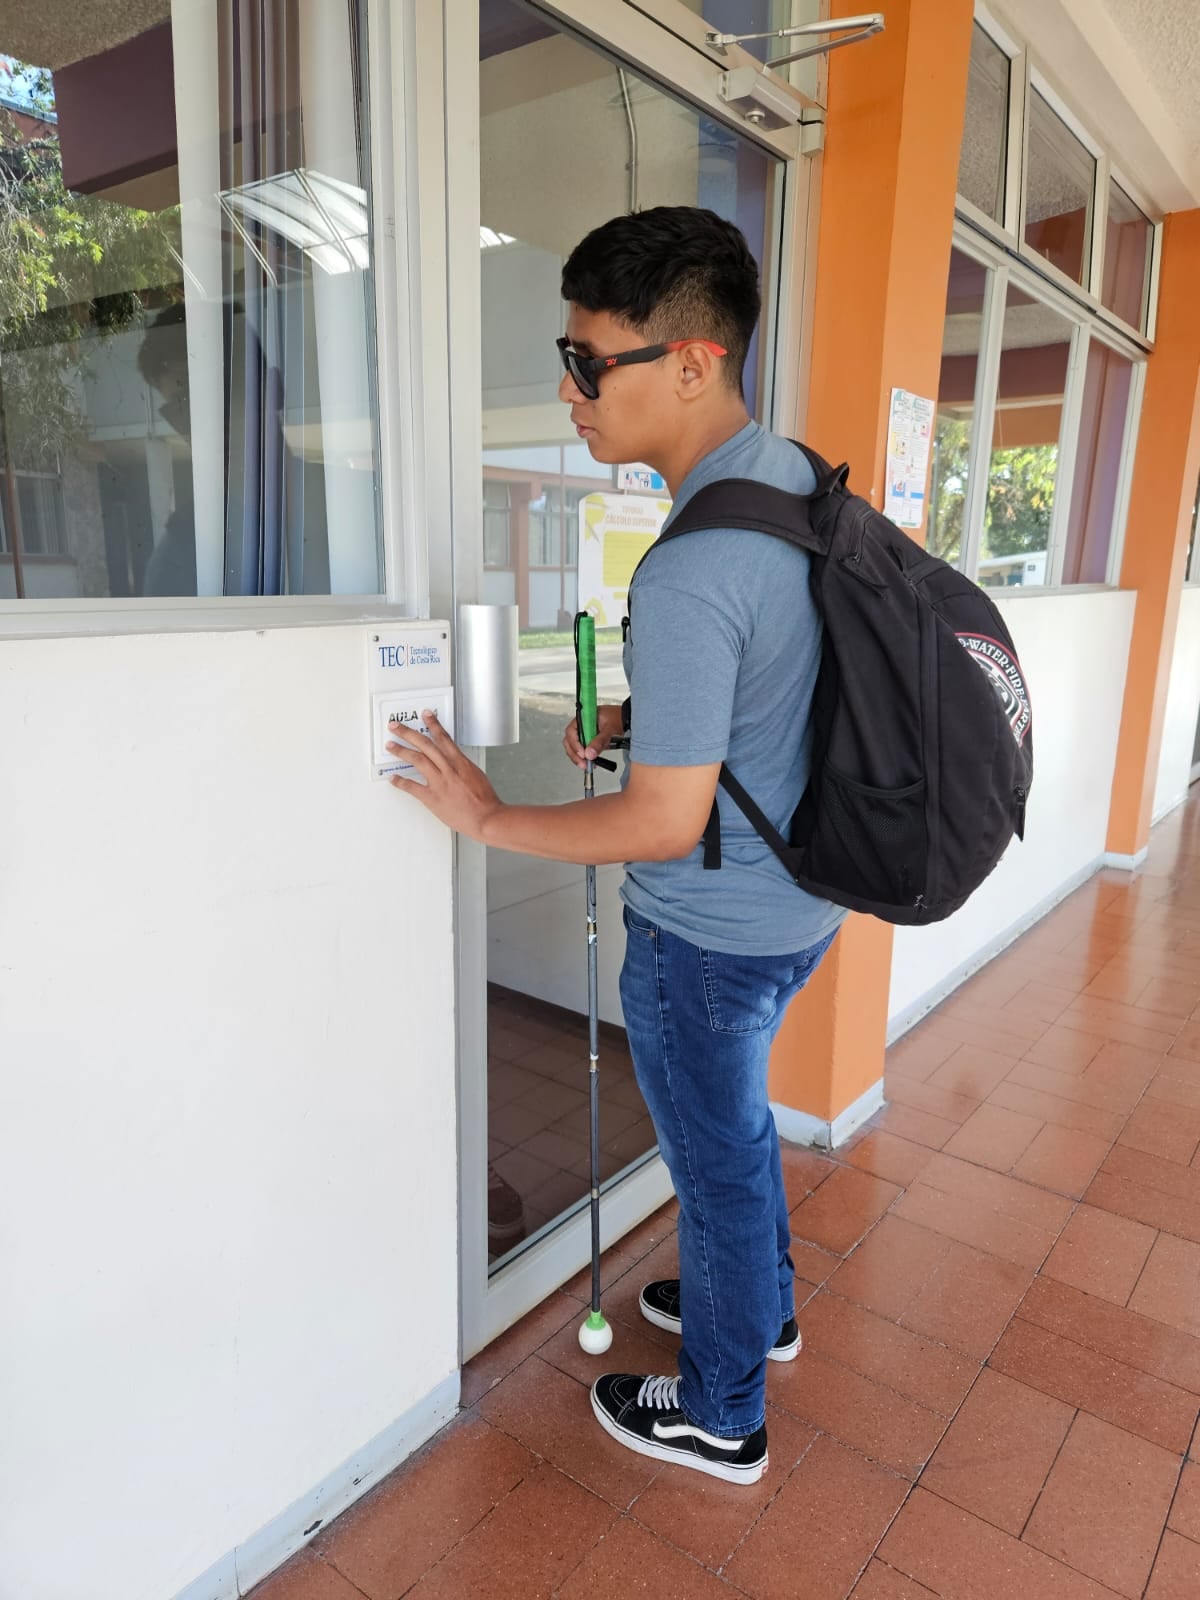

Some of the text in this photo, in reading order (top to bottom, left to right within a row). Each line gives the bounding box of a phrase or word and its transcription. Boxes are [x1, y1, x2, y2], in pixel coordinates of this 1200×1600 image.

[379, 646, 404, 667] TEC
[410, 655, 441, 665] de Costa Rica
[967, 638, 1009, 668] WATER
[1006, 663, 1025, 696] FIRE
[388, 710, 419, 723] AULA
